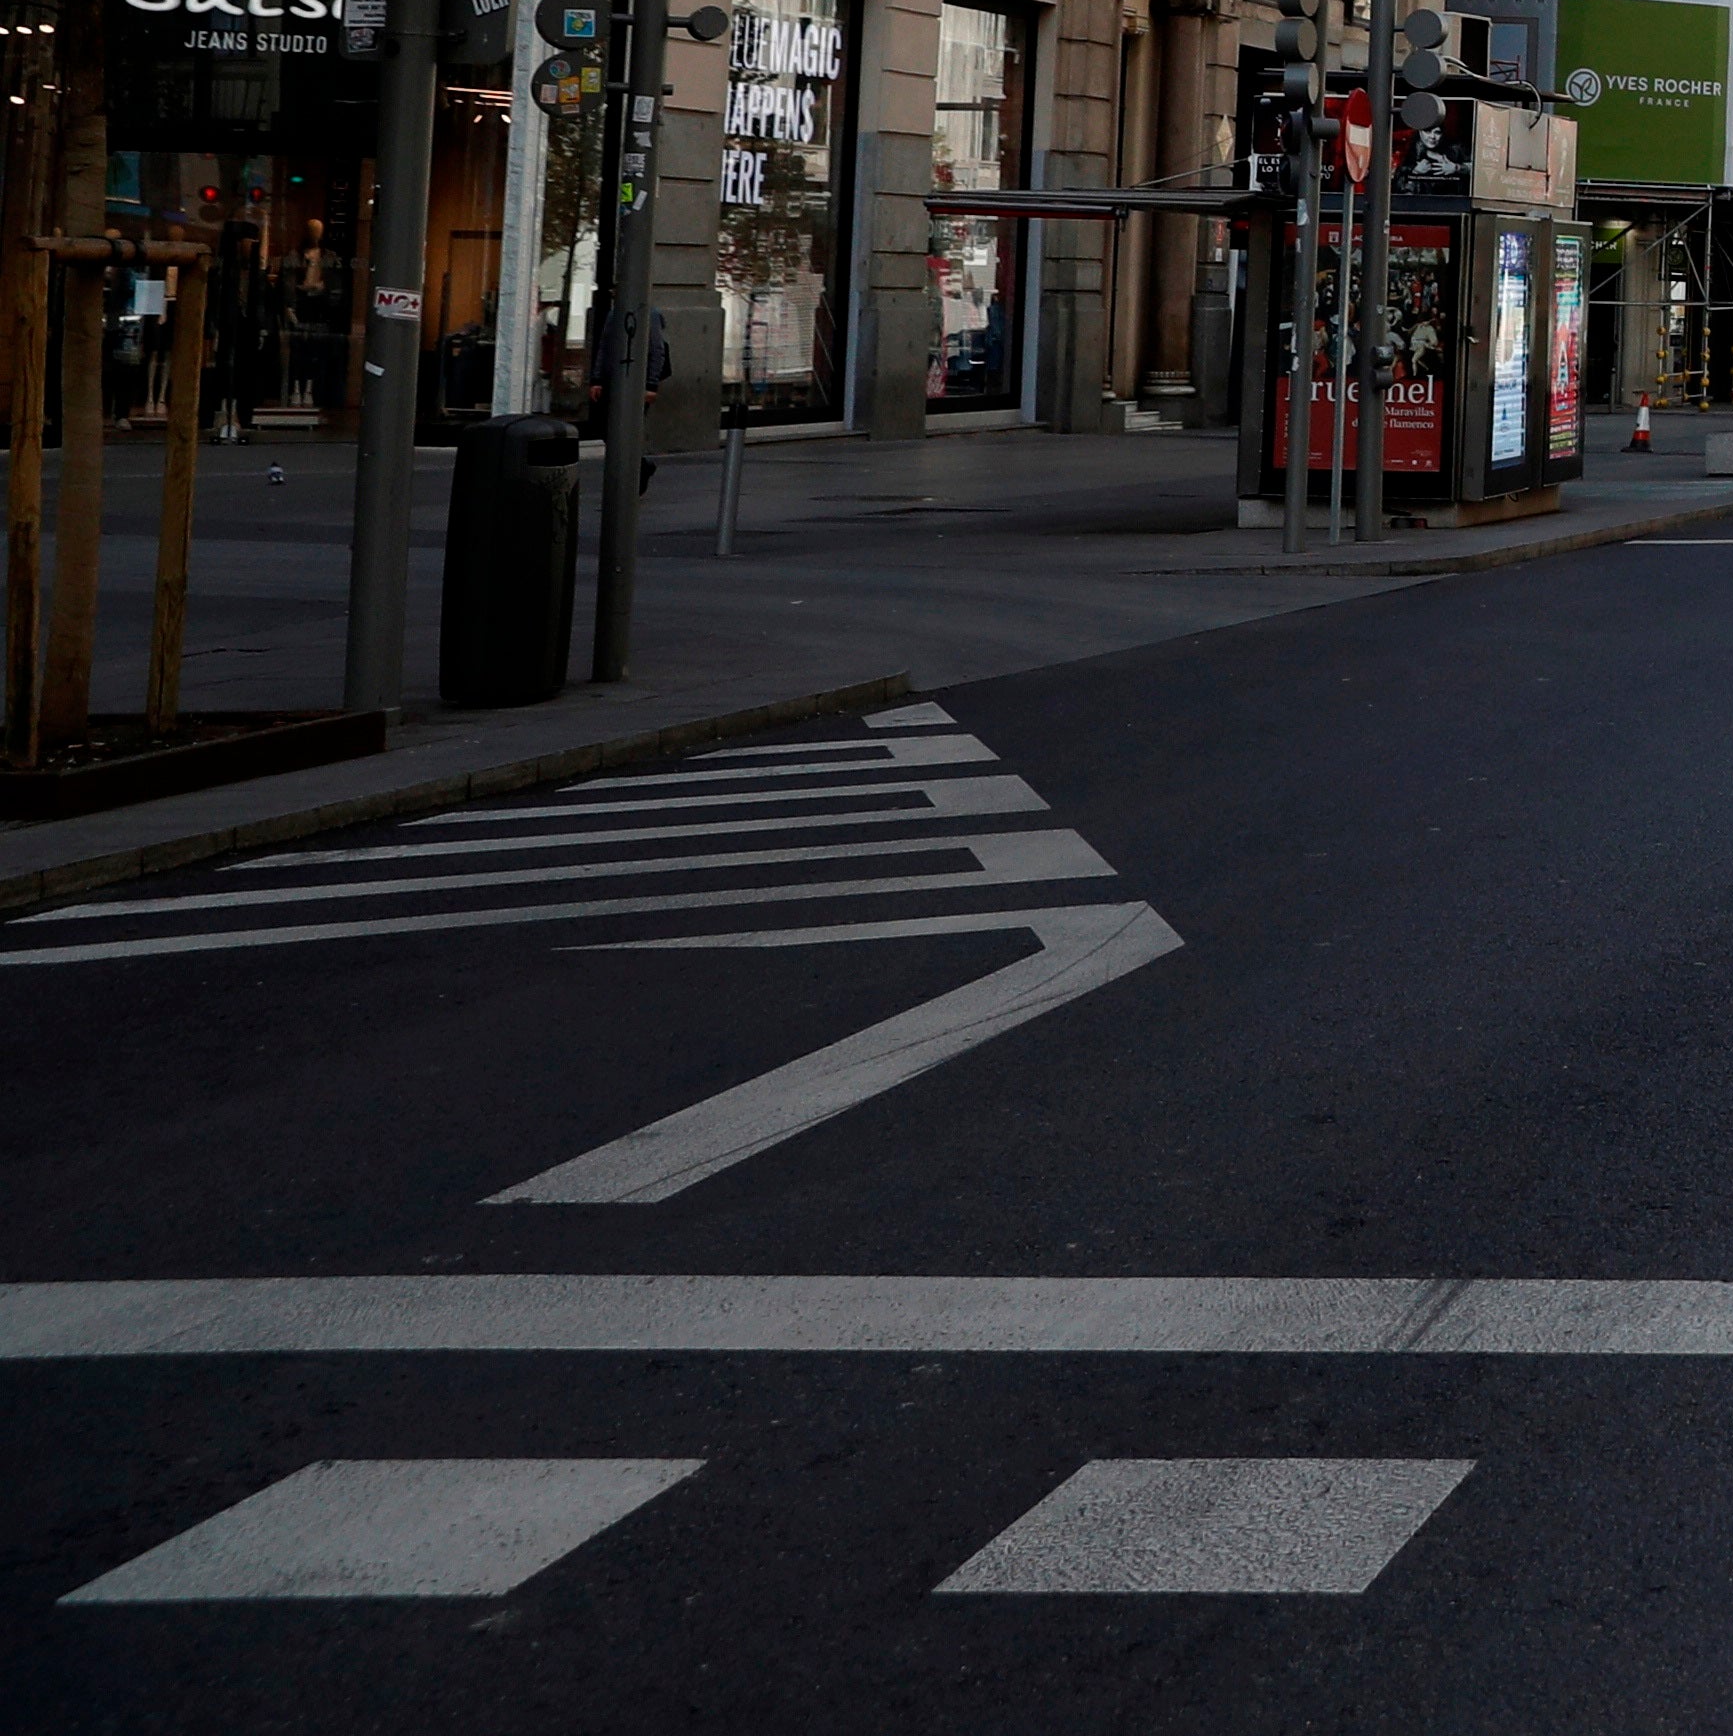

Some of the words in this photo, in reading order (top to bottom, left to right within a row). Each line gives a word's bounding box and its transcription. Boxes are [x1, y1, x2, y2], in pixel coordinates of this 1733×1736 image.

[183, 30, 249, 51] JEANS
[255, 32, 329, 55] STUDIO
[1605, 74, 1649, 92] YVES
[1653, 77, 1723, 97] ROCHER
[1638, 95, 1691, 109] FRANCE
[1390, 417, 1434, 430] flamenco
